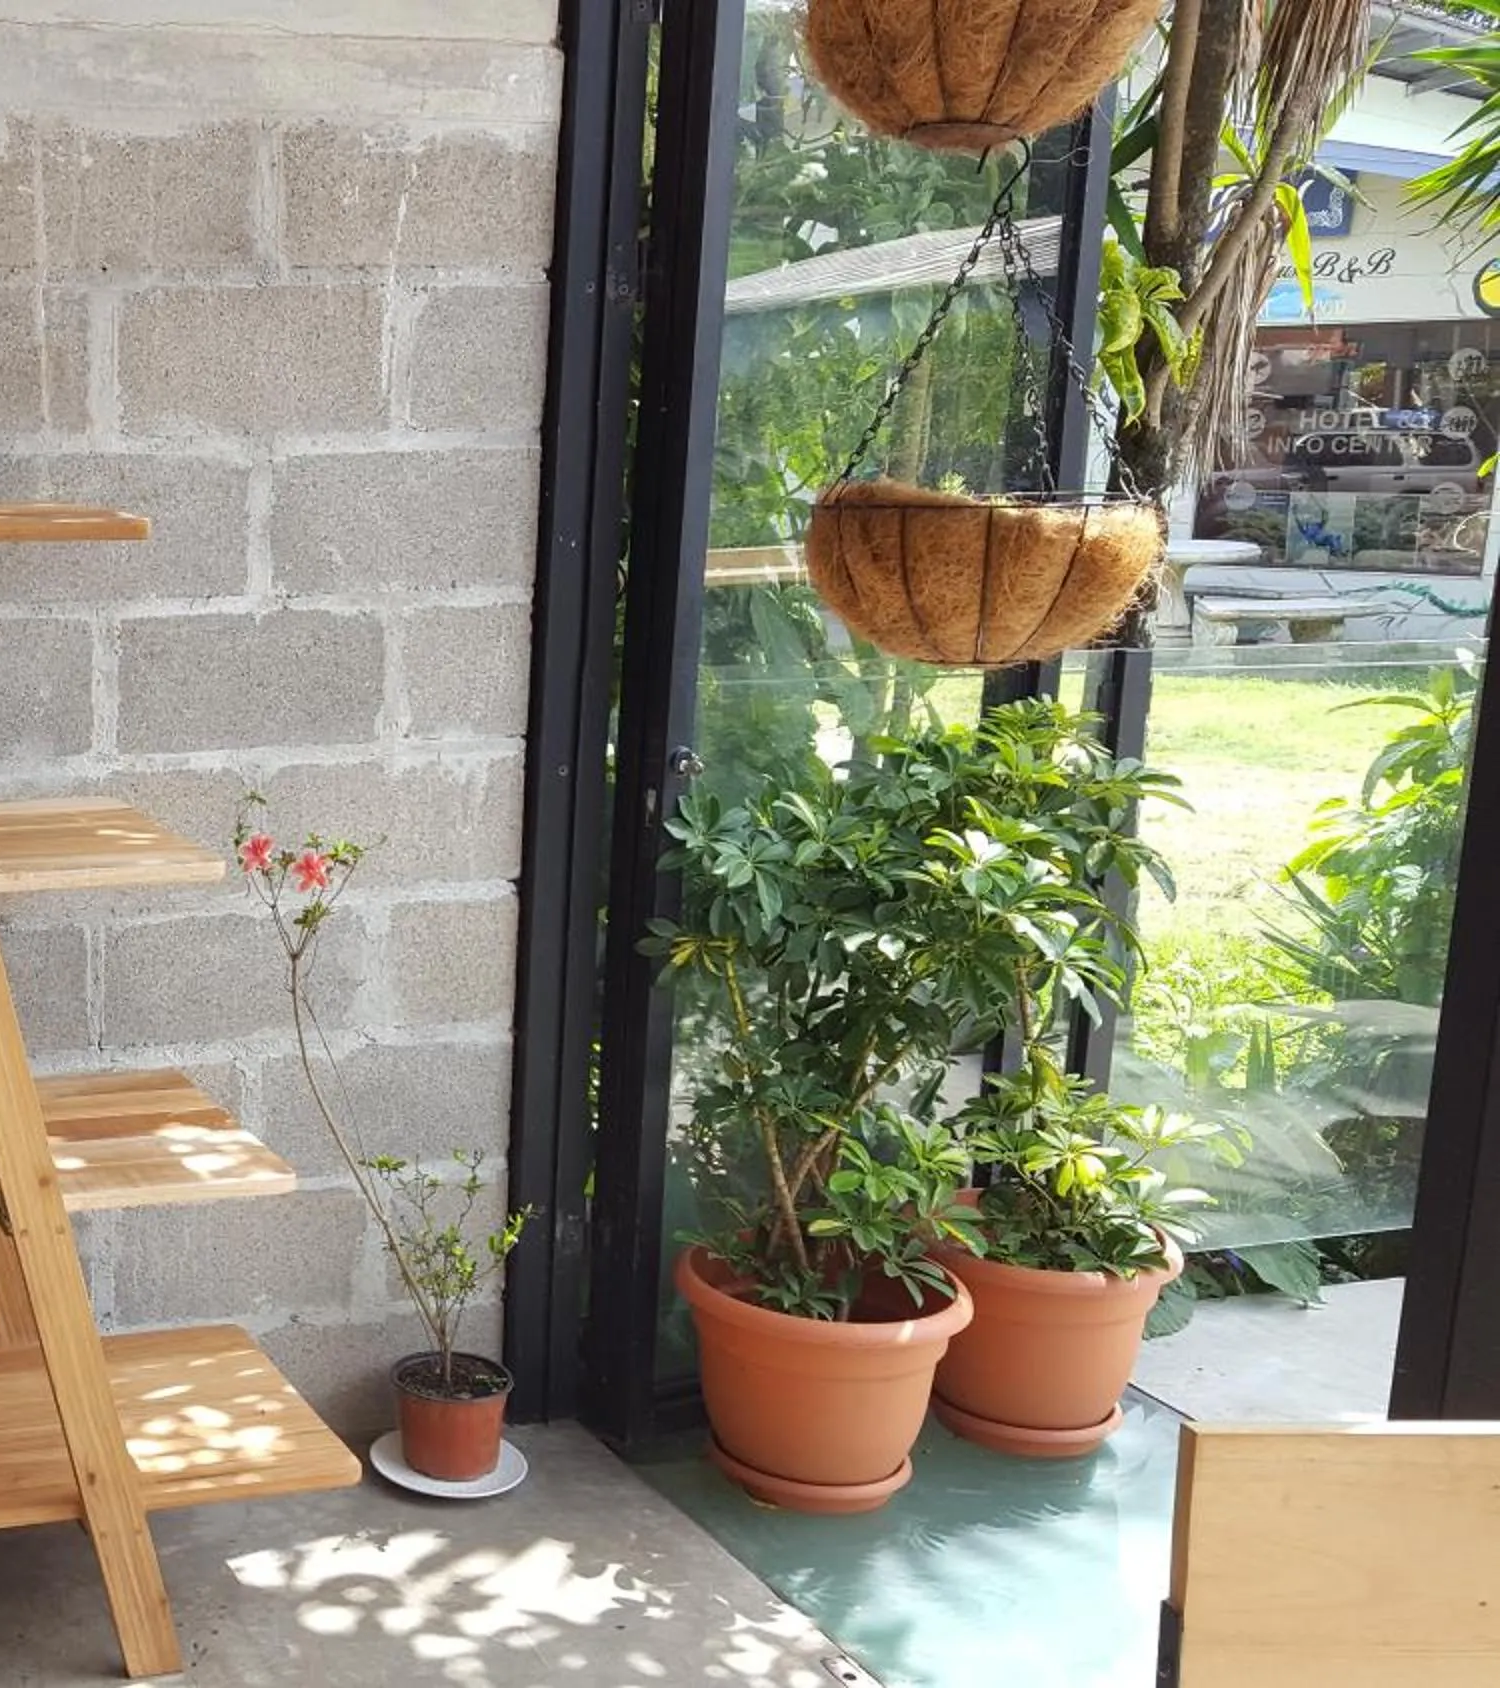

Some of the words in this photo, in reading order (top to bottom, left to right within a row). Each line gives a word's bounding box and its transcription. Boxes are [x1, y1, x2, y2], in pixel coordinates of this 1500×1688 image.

[1299, 409, 1387, 430] HOTEL
[1266, 435, 1325, 454] INFO
[1331, 434, 1433, 455] CENTR
